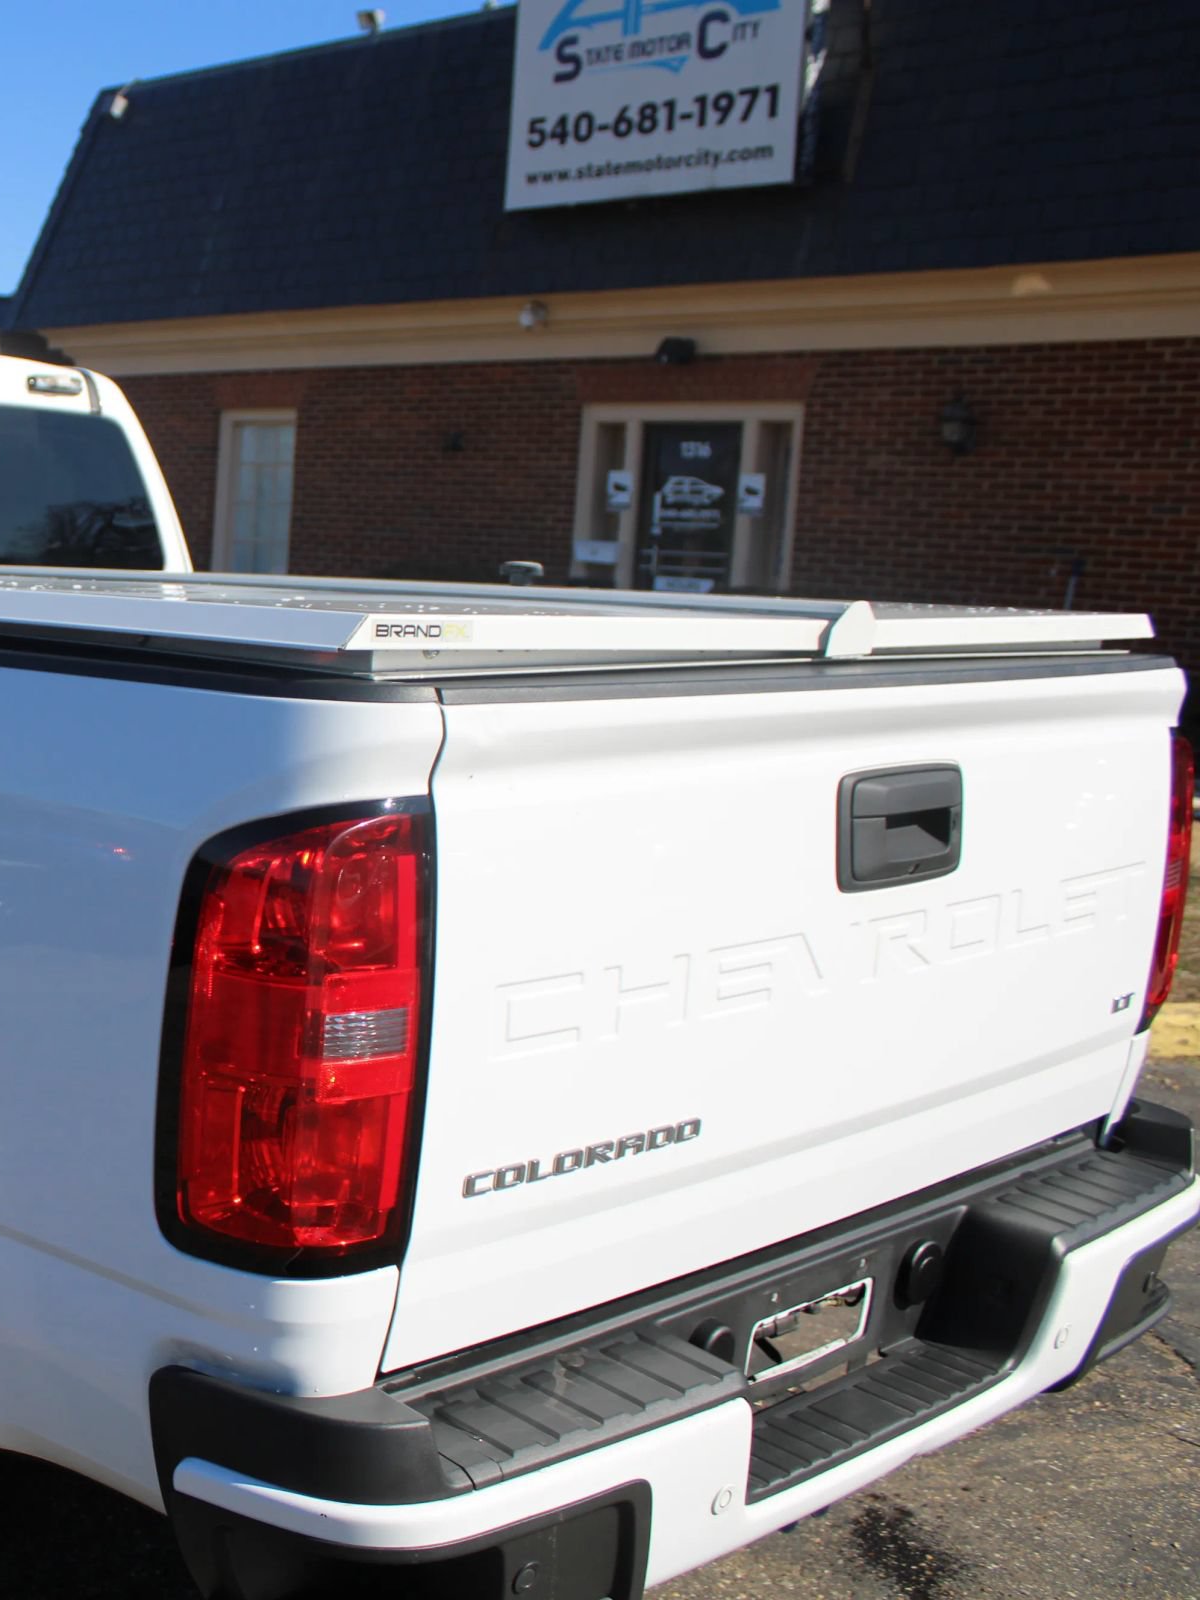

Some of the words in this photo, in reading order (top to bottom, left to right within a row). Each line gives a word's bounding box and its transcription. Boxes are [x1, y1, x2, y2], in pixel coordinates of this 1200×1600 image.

[553, 34, 625, 83] STATE
[628, 32, 692, 60] MOTOR
[697, 9, 762, 61] CITY
[527, 84, 780, 148] 540-681-1971
[526, 144, 775, 184] www.statemotorcity.com
[488, 860, 1146, 1062] CHEVROLET
[1110, 991, 1135, 1014] LT
[462, 1117, 702, 1198] COLORADO
